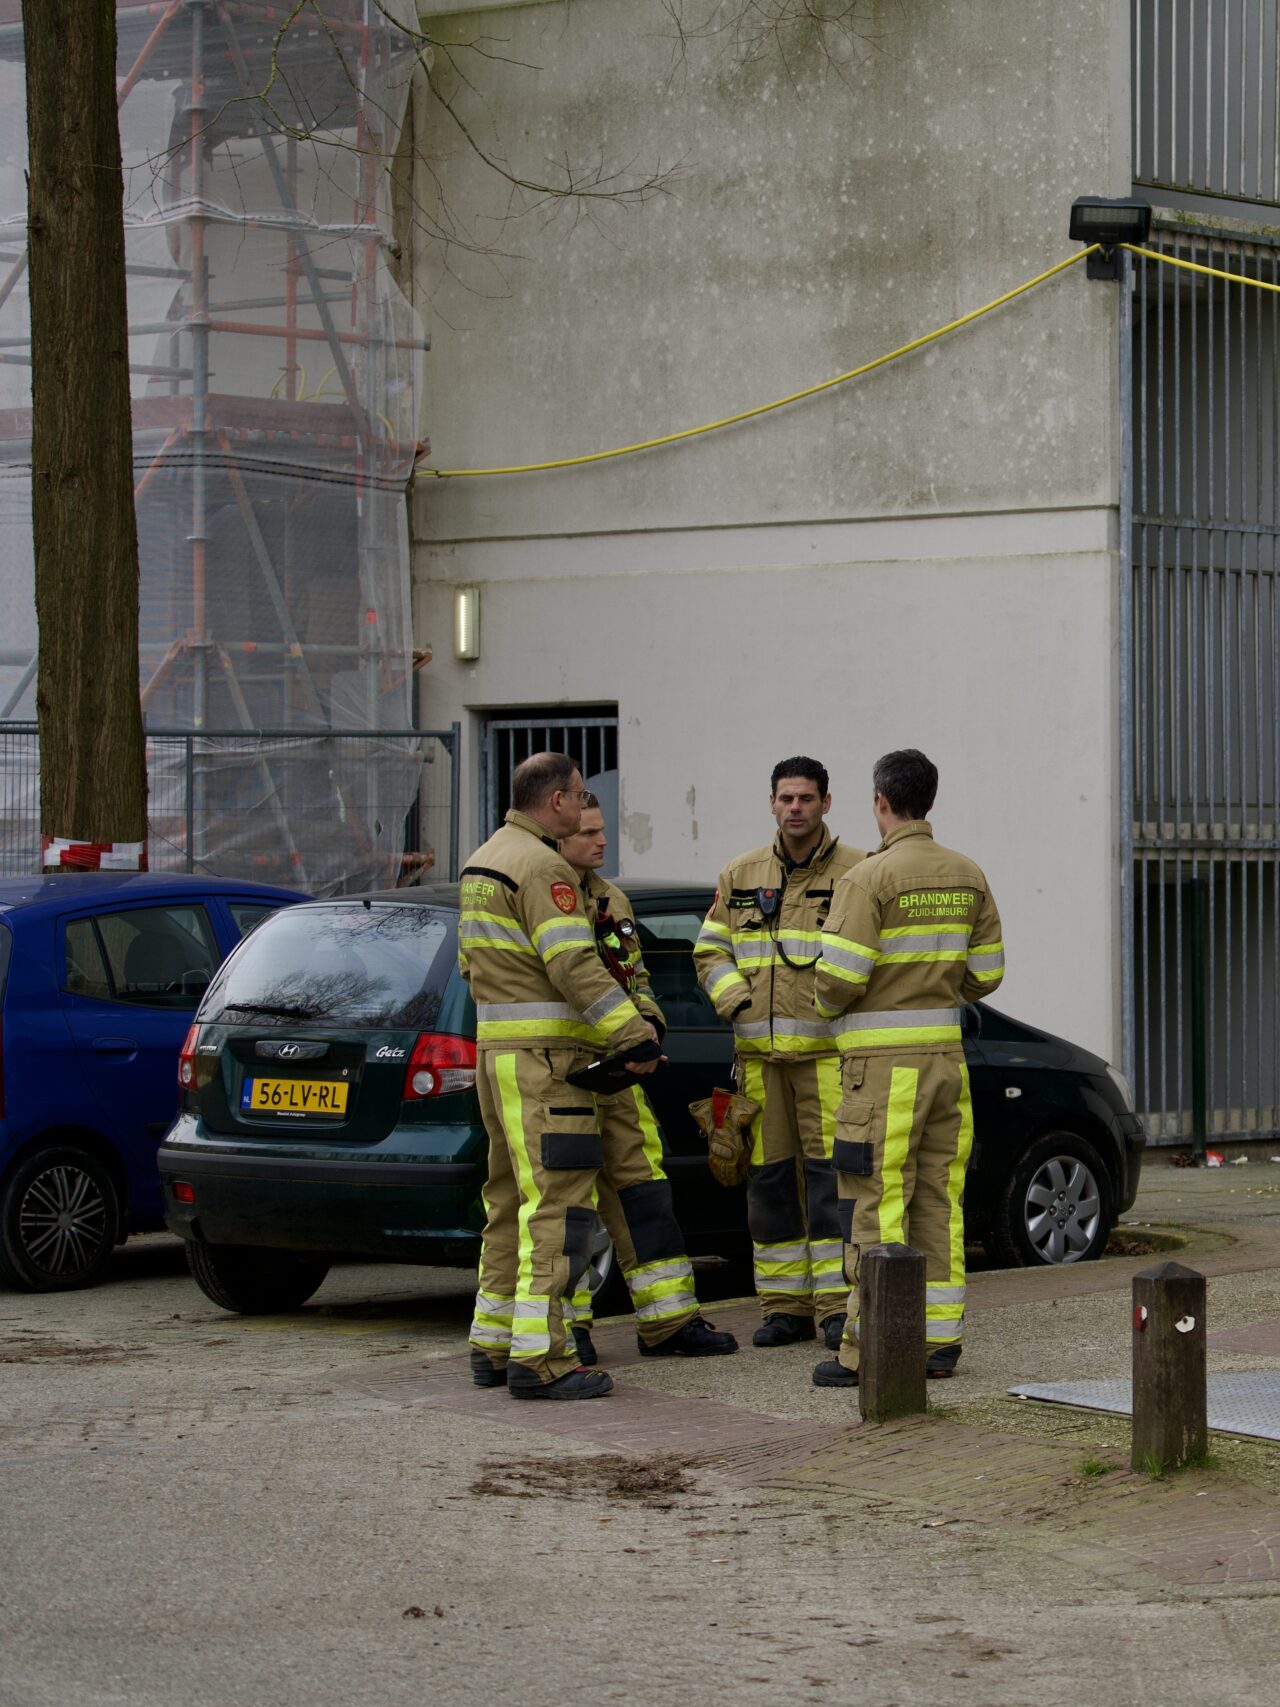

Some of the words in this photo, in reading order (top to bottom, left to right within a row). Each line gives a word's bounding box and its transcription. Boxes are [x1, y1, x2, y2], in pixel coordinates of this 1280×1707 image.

[899, 893, 974, 908] BRANDWEER
[908, 907, 968, 918] ZUID-LIMBURG
[376, 1045, 406, 1058] Getz
[259, 1082, 341, 1109] 56-LV-RL
